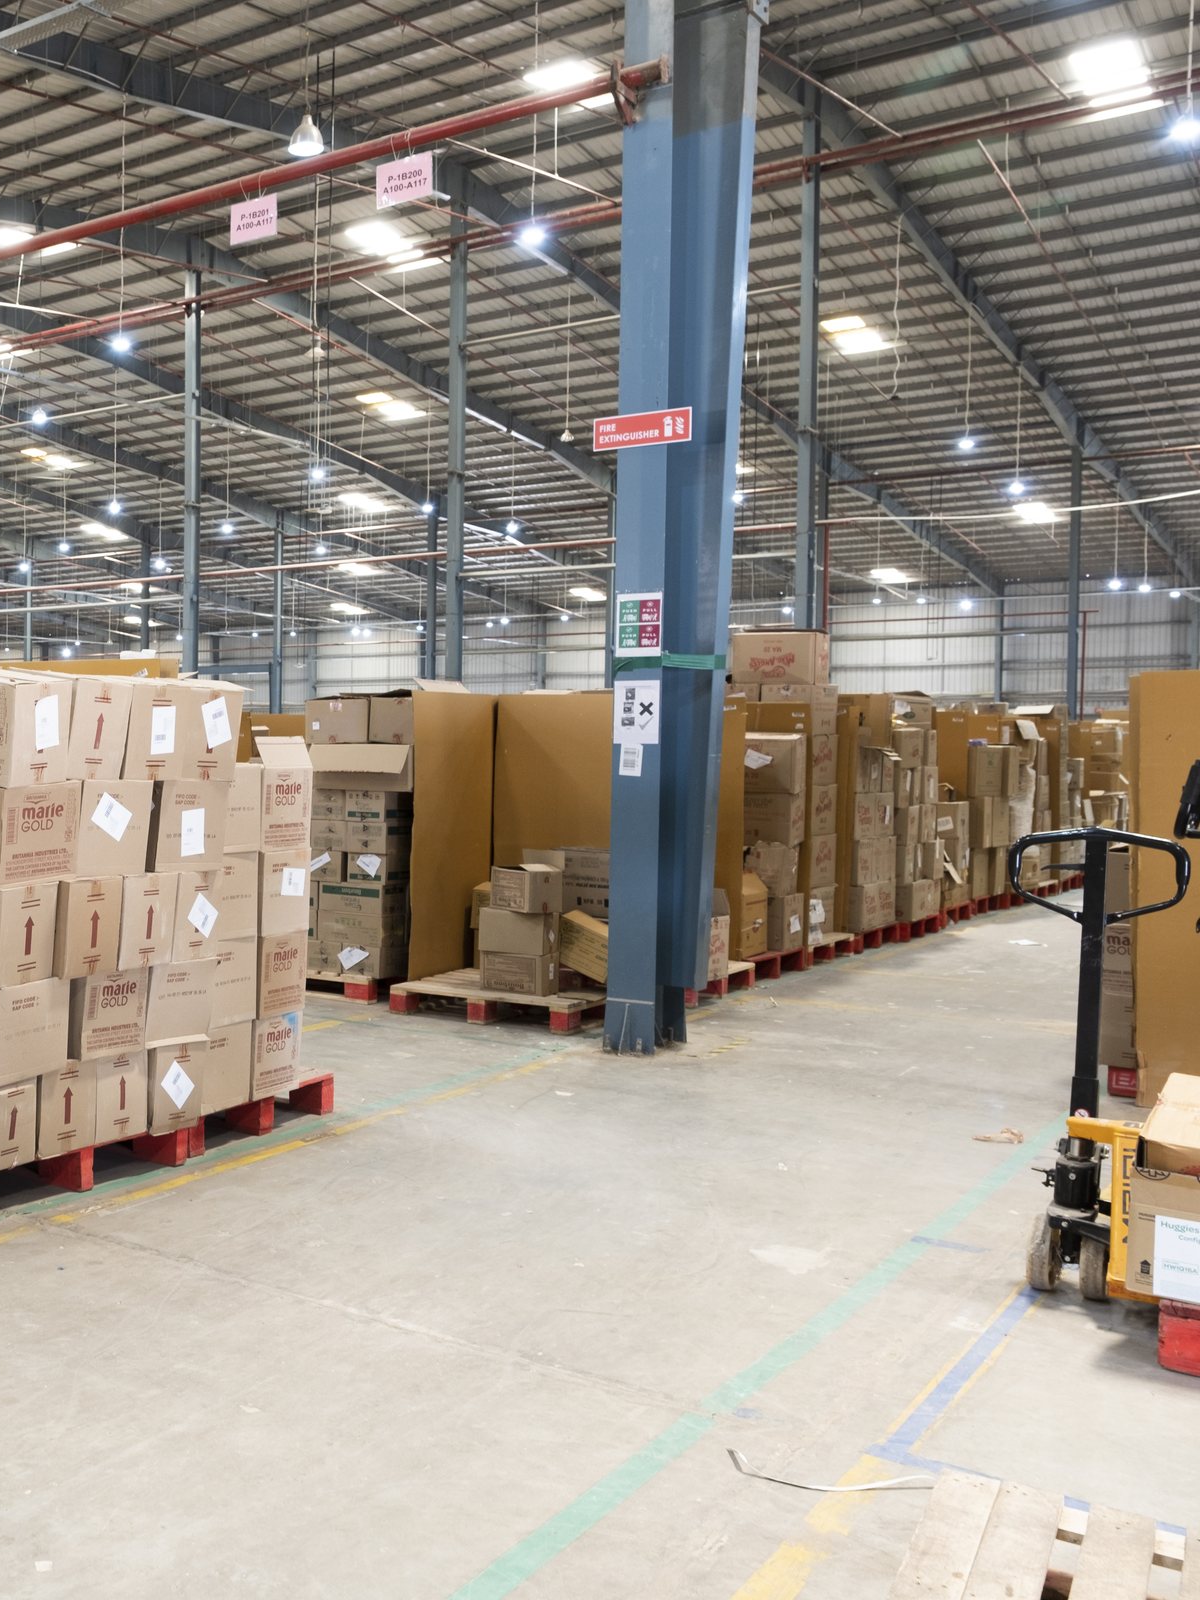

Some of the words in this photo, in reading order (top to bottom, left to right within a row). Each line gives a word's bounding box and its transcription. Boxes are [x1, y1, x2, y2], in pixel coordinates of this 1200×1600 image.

[387, 168, 423, 183] P-1B200
[383, 177, 428, 195] A100-A117
[240, 208, 270, 221] P-1B201
[236, 217, 273, 232] A100-A117
[599, 423, 617, 433] FIRE
[599, 429, 660, 444] EXTINGUISHER
[275, 782, 302, 795] marie
[274, 795, 296, 806] GOLD
[22, 803, 64, 820] marie
[21, 818, 54, 833] GOLD
[273, 947, 298, 963] marie
[272, 960, 293, 973] GOLD
[102, 980, 137, 998] marie
[100, 995, 128, 1009] GOLD
[266, 1028, 292, 1043] marie
[265, 1040, 286, 1054] GOLD
[1160, 1220, 1200, 1234] Huggies
